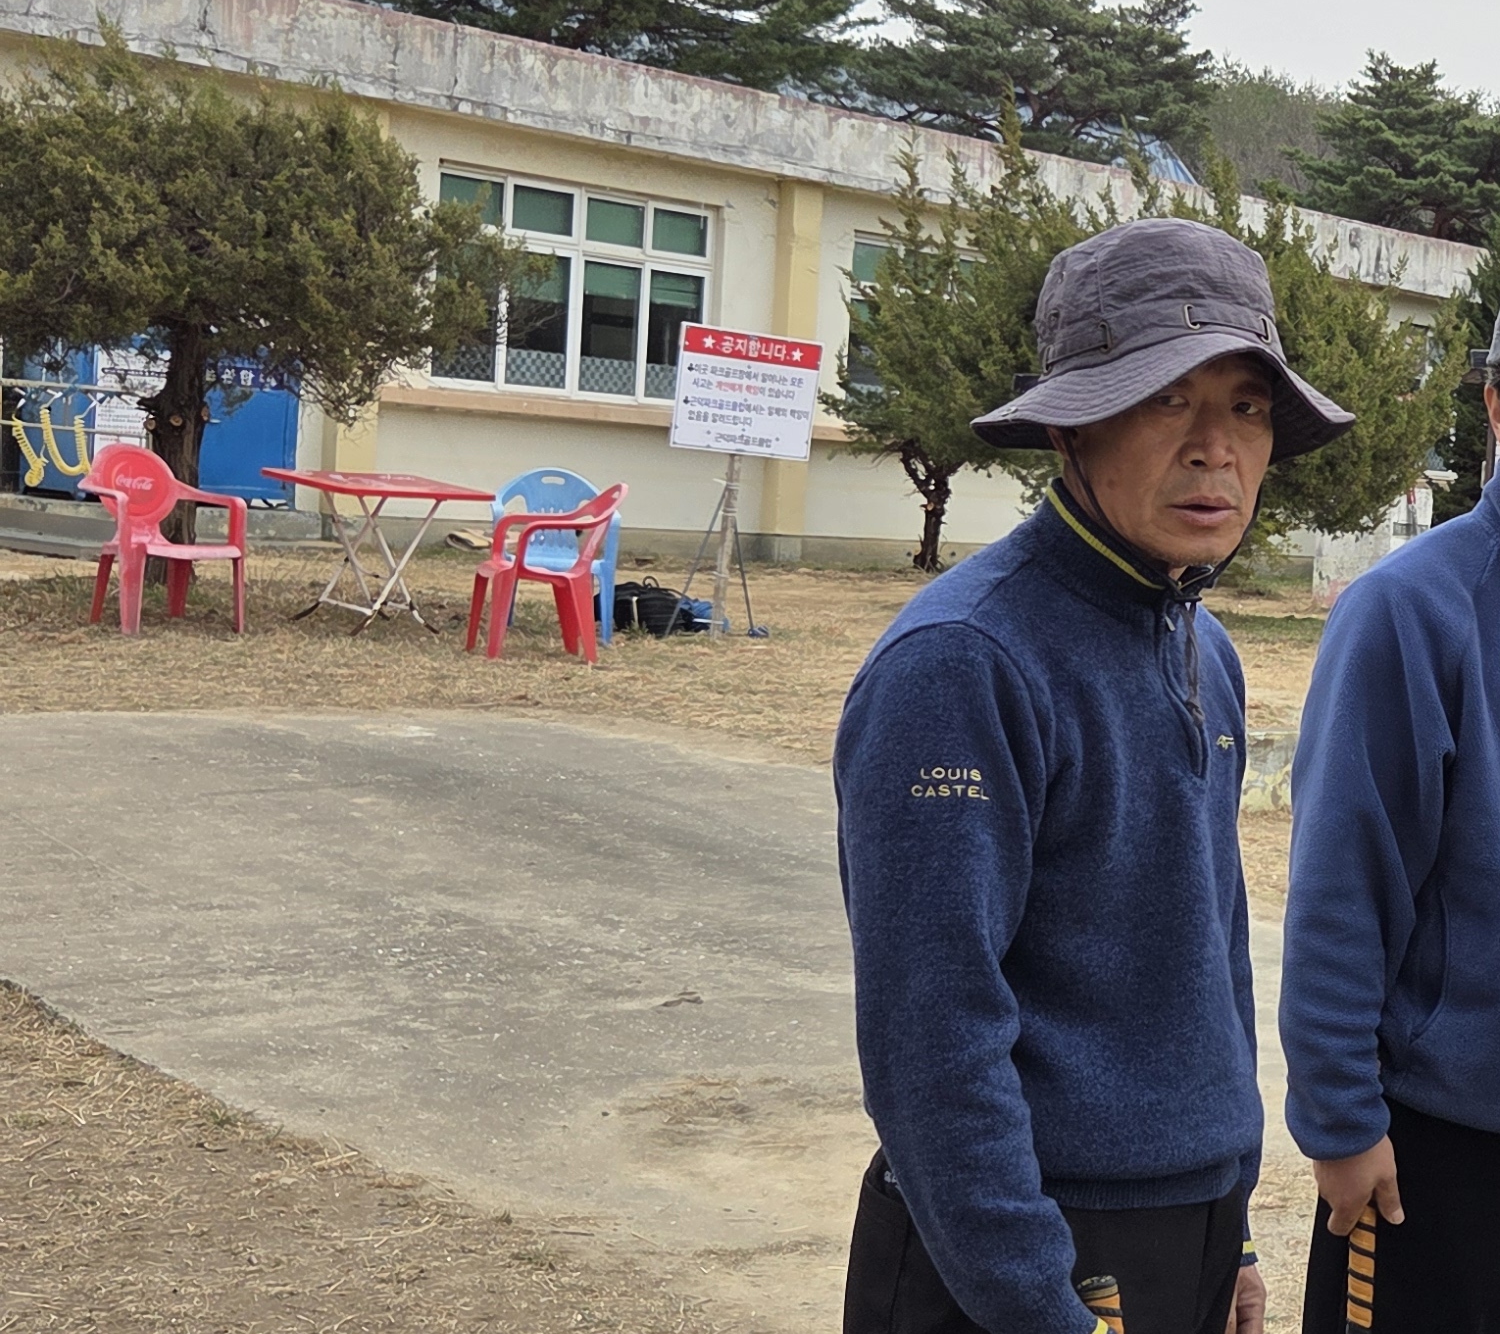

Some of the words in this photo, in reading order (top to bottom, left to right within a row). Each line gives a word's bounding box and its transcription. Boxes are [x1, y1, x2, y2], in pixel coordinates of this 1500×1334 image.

[692, 377, 714, 390] 사고는
[790, 377, 804, 388] 모든
[920, 767, 982, 781] LOUIS
[911, 784, 990, 800] CASTEL
